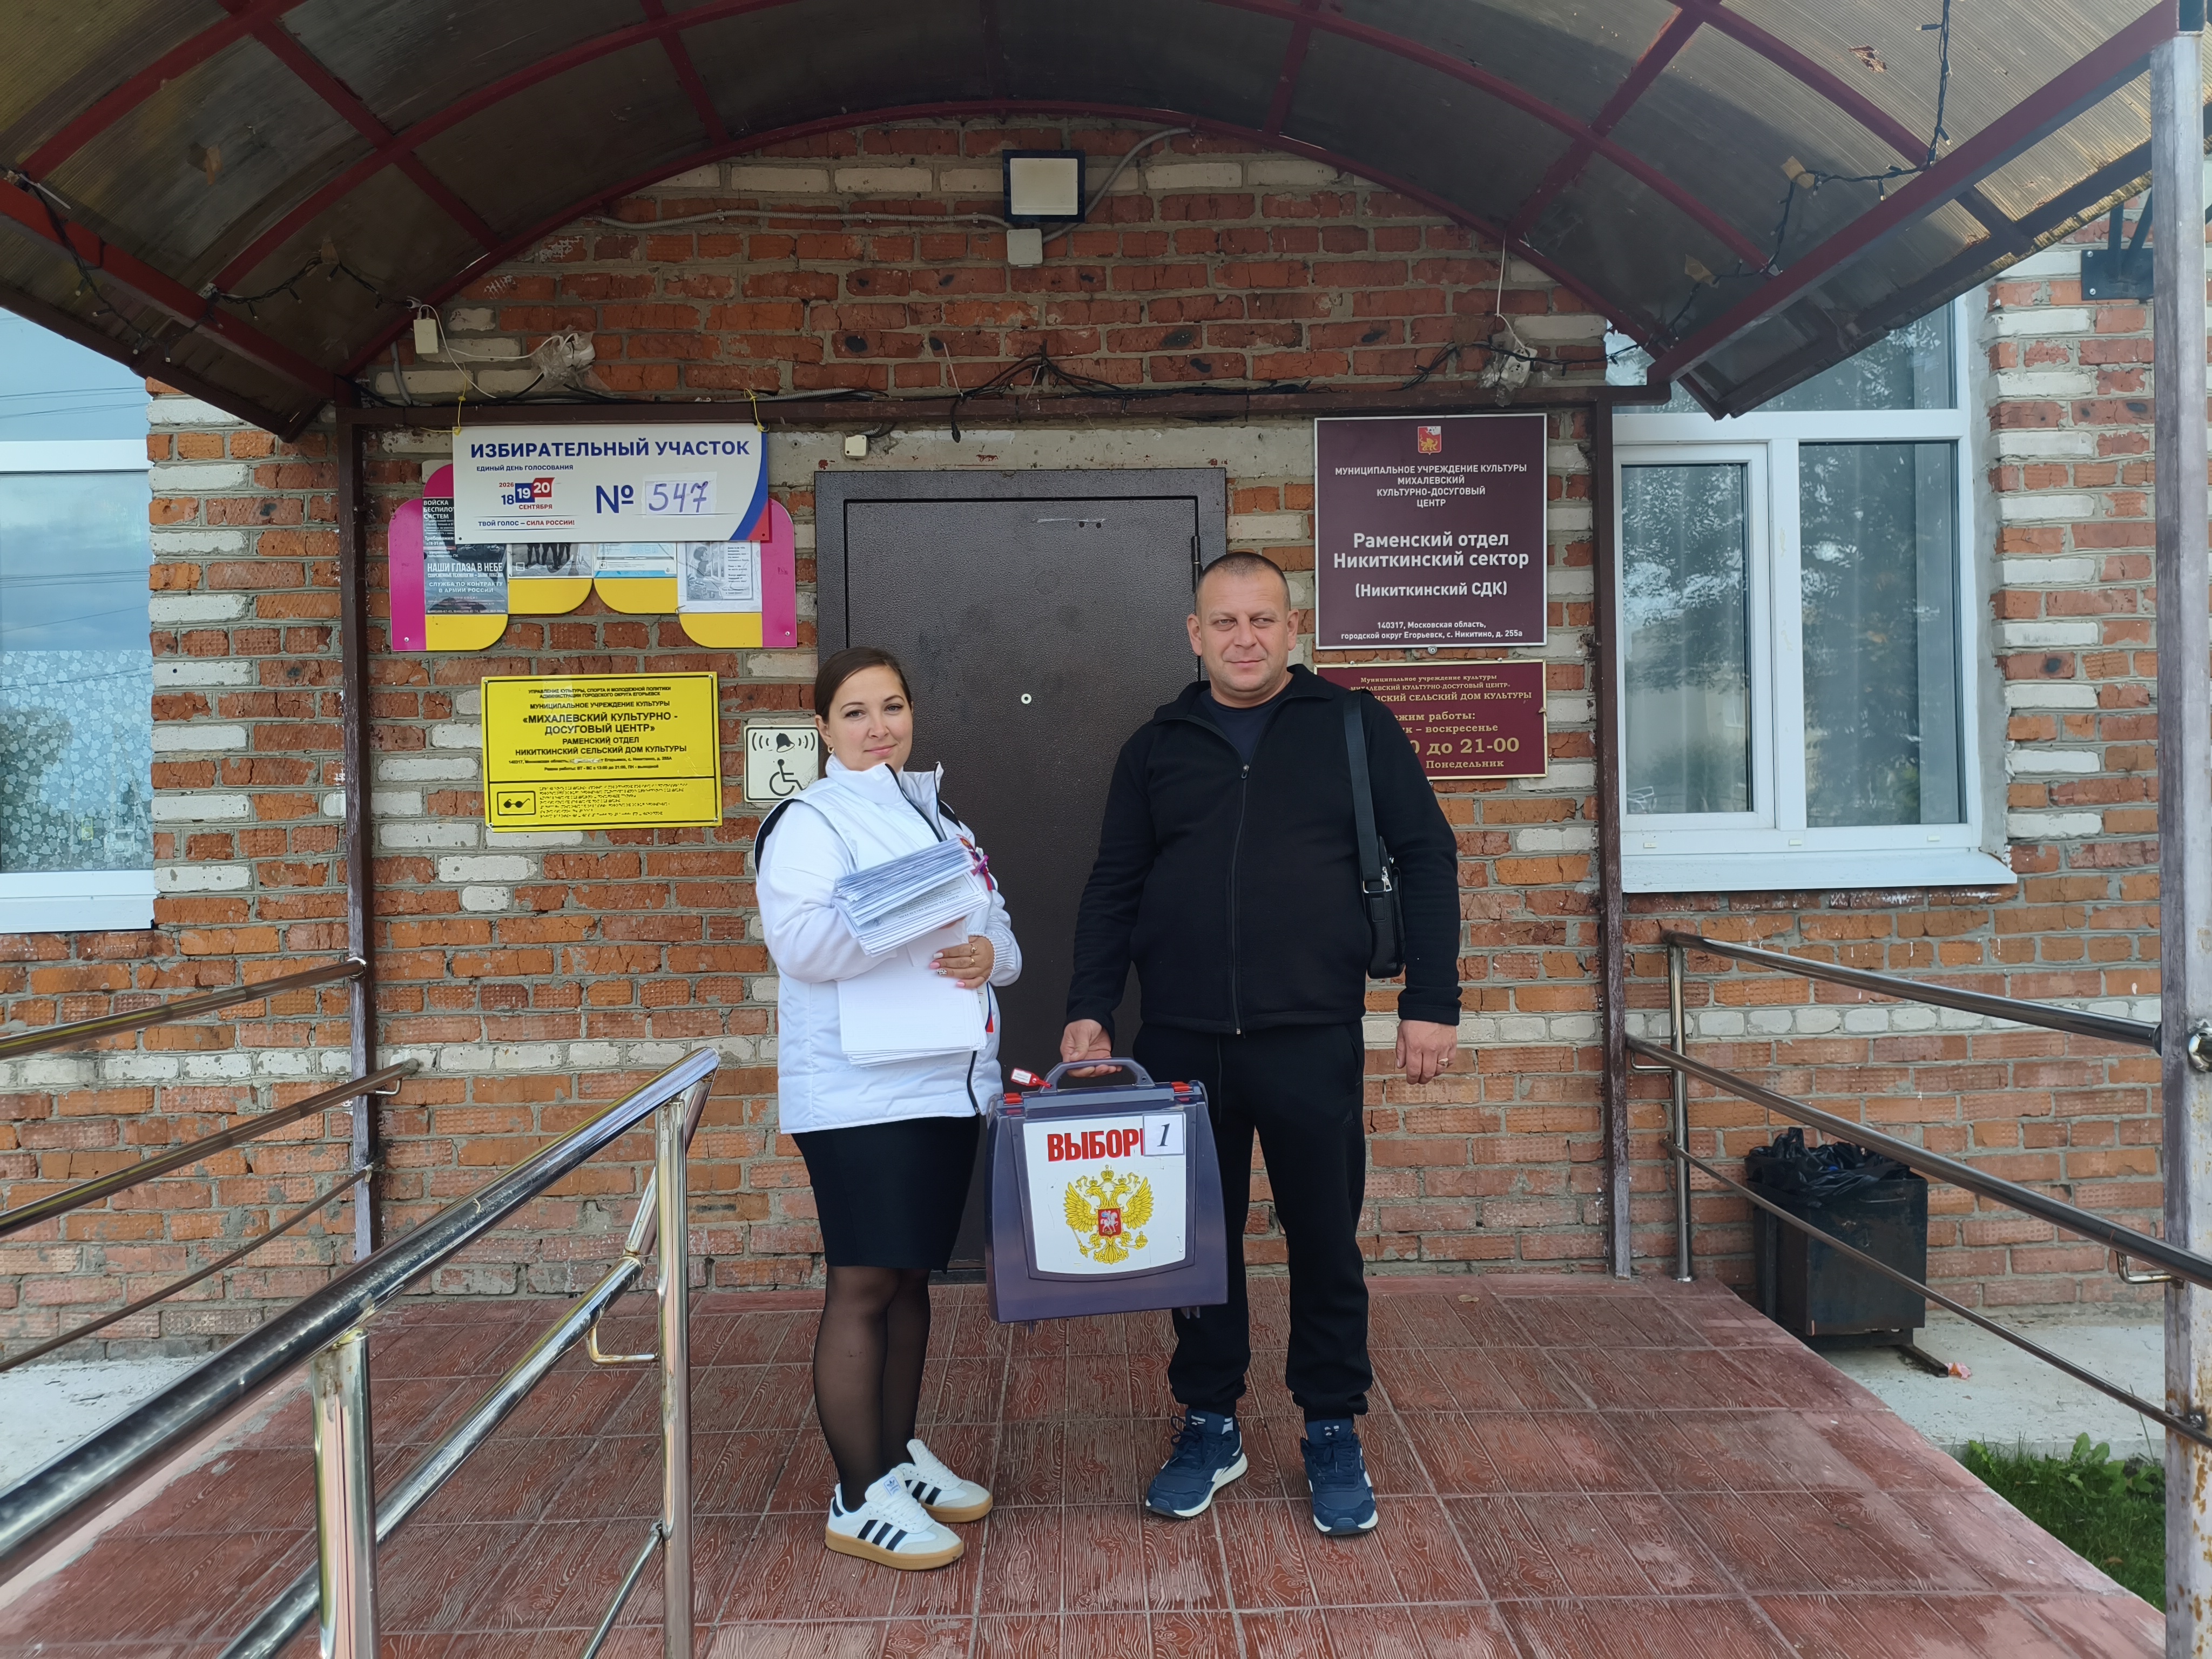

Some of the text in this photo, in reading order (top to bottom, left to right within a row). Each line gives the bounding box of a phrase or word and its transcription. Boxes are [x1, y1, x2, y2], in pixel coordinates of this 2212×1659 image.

[471, 437, 751, 458] ИЗБИРАТЕЛЬНЫЙ УЧАСТОК
[1335, 464, 1527, 476] МУНИЦИПАЛЬНОЕ УЧРЕЖДЕНИЕ КУЛЬТУРЫ
[1398, 475, 1465, 485] МИХАЛЕВСКИЙ
[501, 482, 550, 505] 18 19 20
[1377, 485, 1486, 497] КУЛЬТУРНО-ДОСУГОВЫЙ
[596, 481, 709, 514] № 547
[1417, 498, 1446, 508] ЦЕНТР
[1353, 531, 1508, 549] Раменский отдел
[1334, 551, 1529, 569] Никиткинский сектор
[427, 563, 450, 572] НАШИ
[451, 563, 476, 572] ГЛАЗА
[477, 563, 482, 572] В
[484, 563, 503, 572] НЕБЕ
[1355, 581, 1508, 598] (Никиткинский СДК)
[1377, 619, 1486, 630] 140317, Московская область,
[1341, 631, 1380, 641] городской
[1381, 631, 1402, 640] округ
[1404, 631, 1445, 640] Егорьевск,
[1455, 630, 1495, 638] Никитино,
[1402, 682, 1483, 690] КУЛЬТУРНО-ДОСУГОВЫЙ
[1409, 692, 1458, 702] СЕЛЬСКИЙ
[1460, 693, 1481, 701] ДОМ
[1484, 692, 1532, 700] КУЛЬТУРЫ
[523, 711, 608, 724] «МИХАЛЕВСКИЙ
[611, 712, 671, 722] КУЛЬТУРНО
[1394, 711, 1476, 723] ежим работы:
[544, 723, 655, 736] ДОСУГОВЫЙ ЦЕНТР»
[1425, 724, 1499, 734] воскресенье
[562, 737, 611, 745] РАМЕНСКИЙ
[1426, 743, 1453, 756] до
[1460, 737, 1520, 754] 21-00
[515, 745, 687, 756] НИКИТКИНСКИЙ СЕЛЬСКИЙ ДОМ КУЛЬТУРЫ
[1426, 760, 1505, 769] Понедельник
[1157, 1123, 1170, 1148] 1
